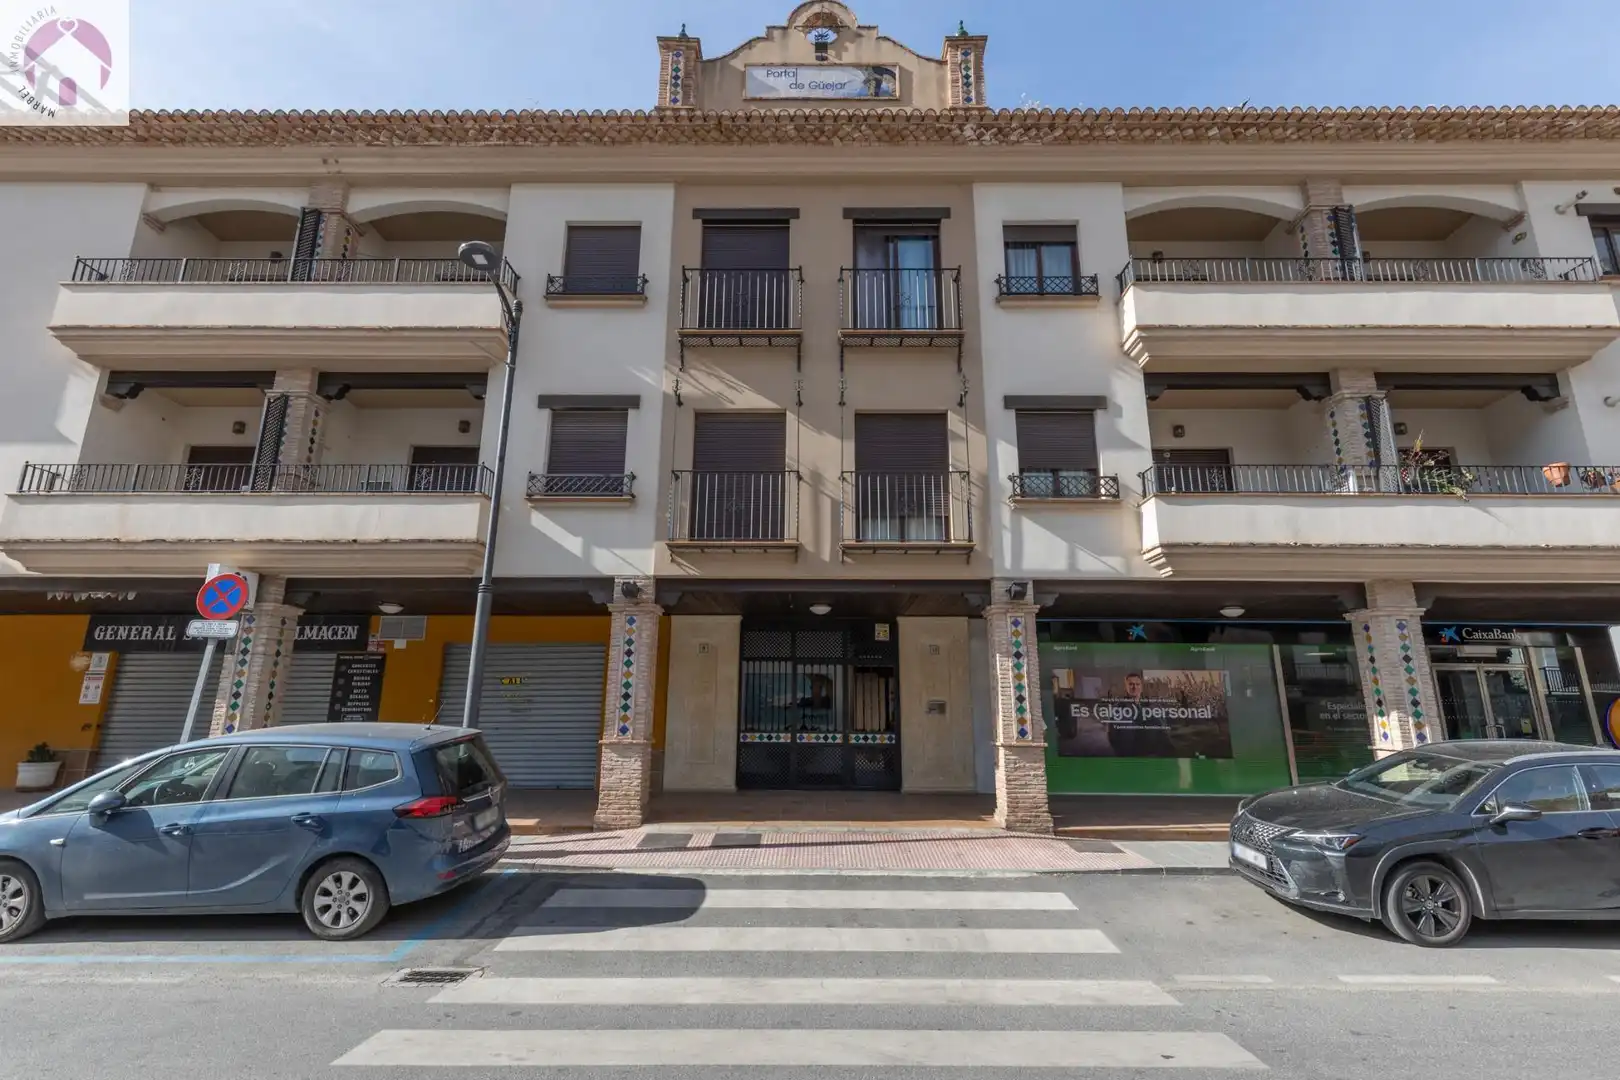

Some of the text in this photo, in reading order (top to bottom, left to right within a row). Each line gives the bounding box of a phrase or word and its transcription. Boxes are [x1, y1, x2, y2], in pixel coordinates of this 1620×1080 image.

[766, 67, 798, 80] Portal
[789, 79, 847, 91] de Güejar
[94, 625, 177, 641] GENERAL
[294, 625, 360, 641] LMACEN
[1462, 627, 1522, 641] CaixaBank
[1070, 703, 1212, 721] Es (algo) personal
[1342, 711, 1365, 720] secto
